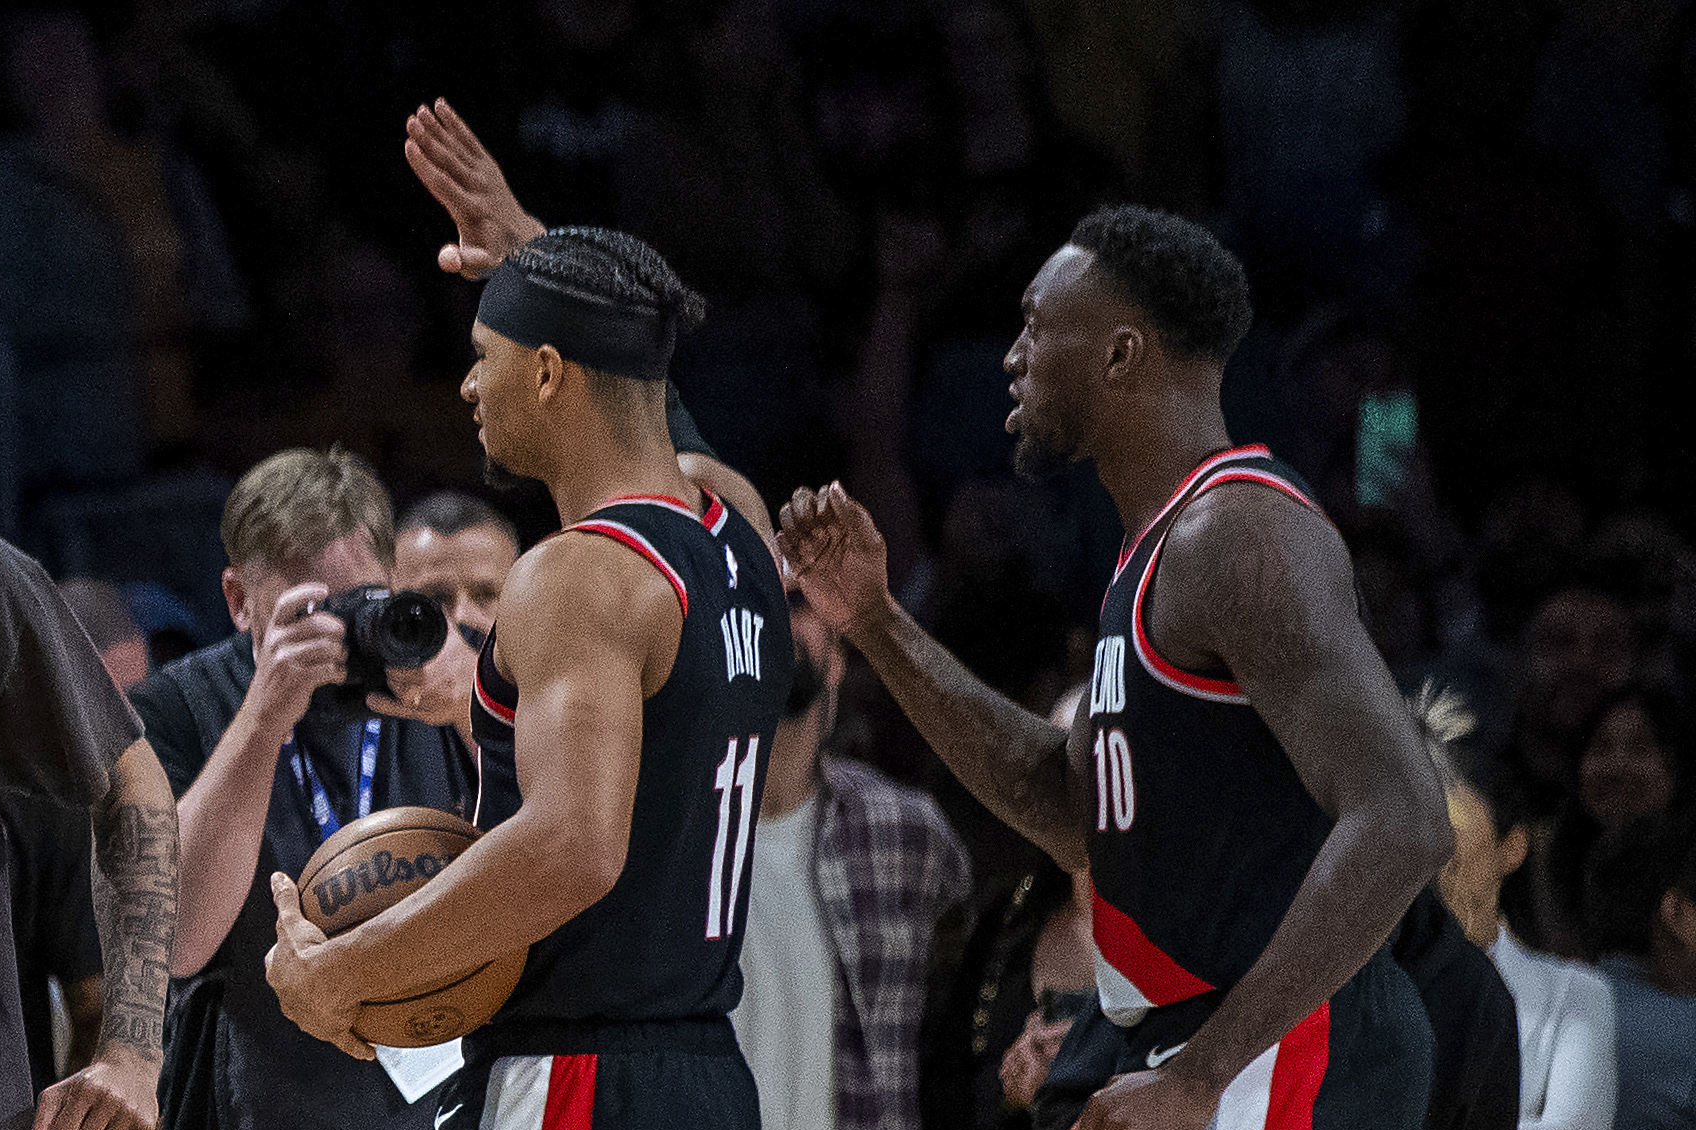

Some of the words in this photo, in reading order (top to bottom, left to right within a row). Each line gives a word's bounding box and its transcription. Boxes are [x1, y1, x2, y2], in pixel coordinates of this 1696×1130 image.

[1094, 727, 1136, 833] 10
[313, 850, 456, 917] Wilso
[705, 735, 760, 940] 11
